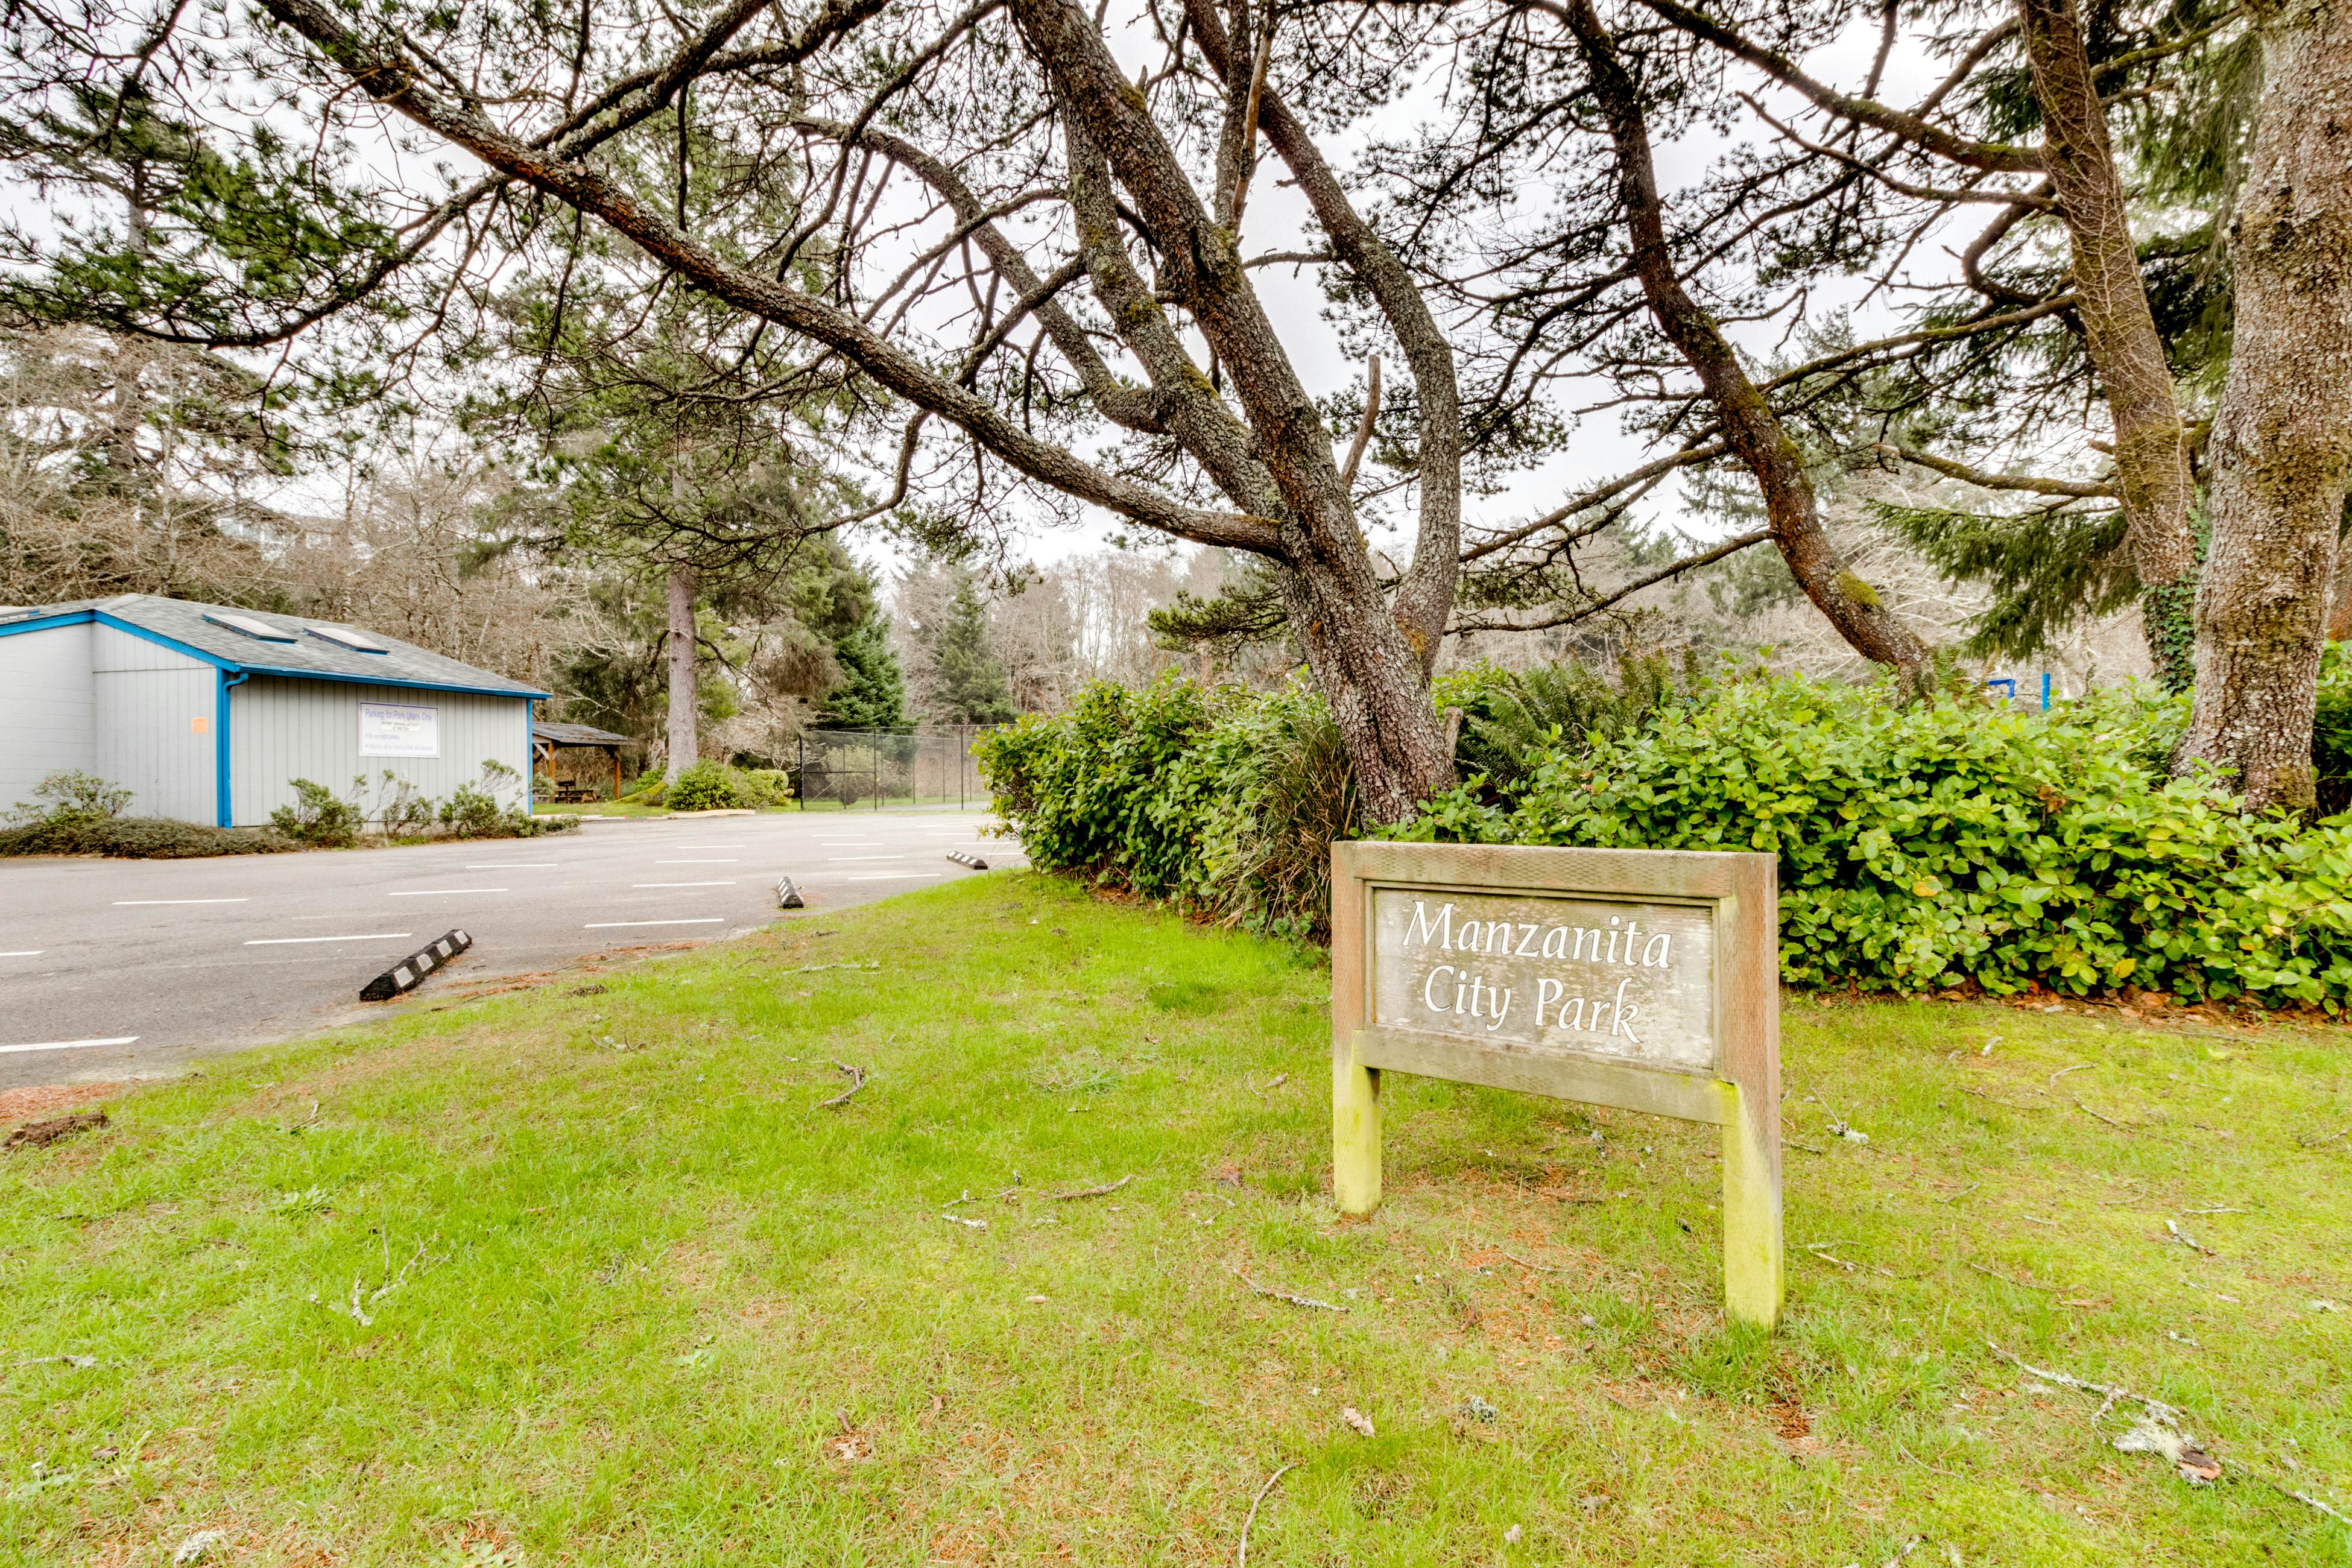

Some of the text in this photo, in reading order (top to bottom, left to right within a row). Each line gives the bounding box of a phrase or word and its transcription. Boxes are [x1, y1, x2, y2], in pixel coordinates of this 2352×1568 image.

[365, 709, 384, 718] Parking
[394, 710, 405, 719] Park
[406, 712, 420, 721] Users
[422, 712, 432, 722] Only
[1401, 900, 1673, 969] Manzanita
[1424, 964, 1643, 1044] City Park
